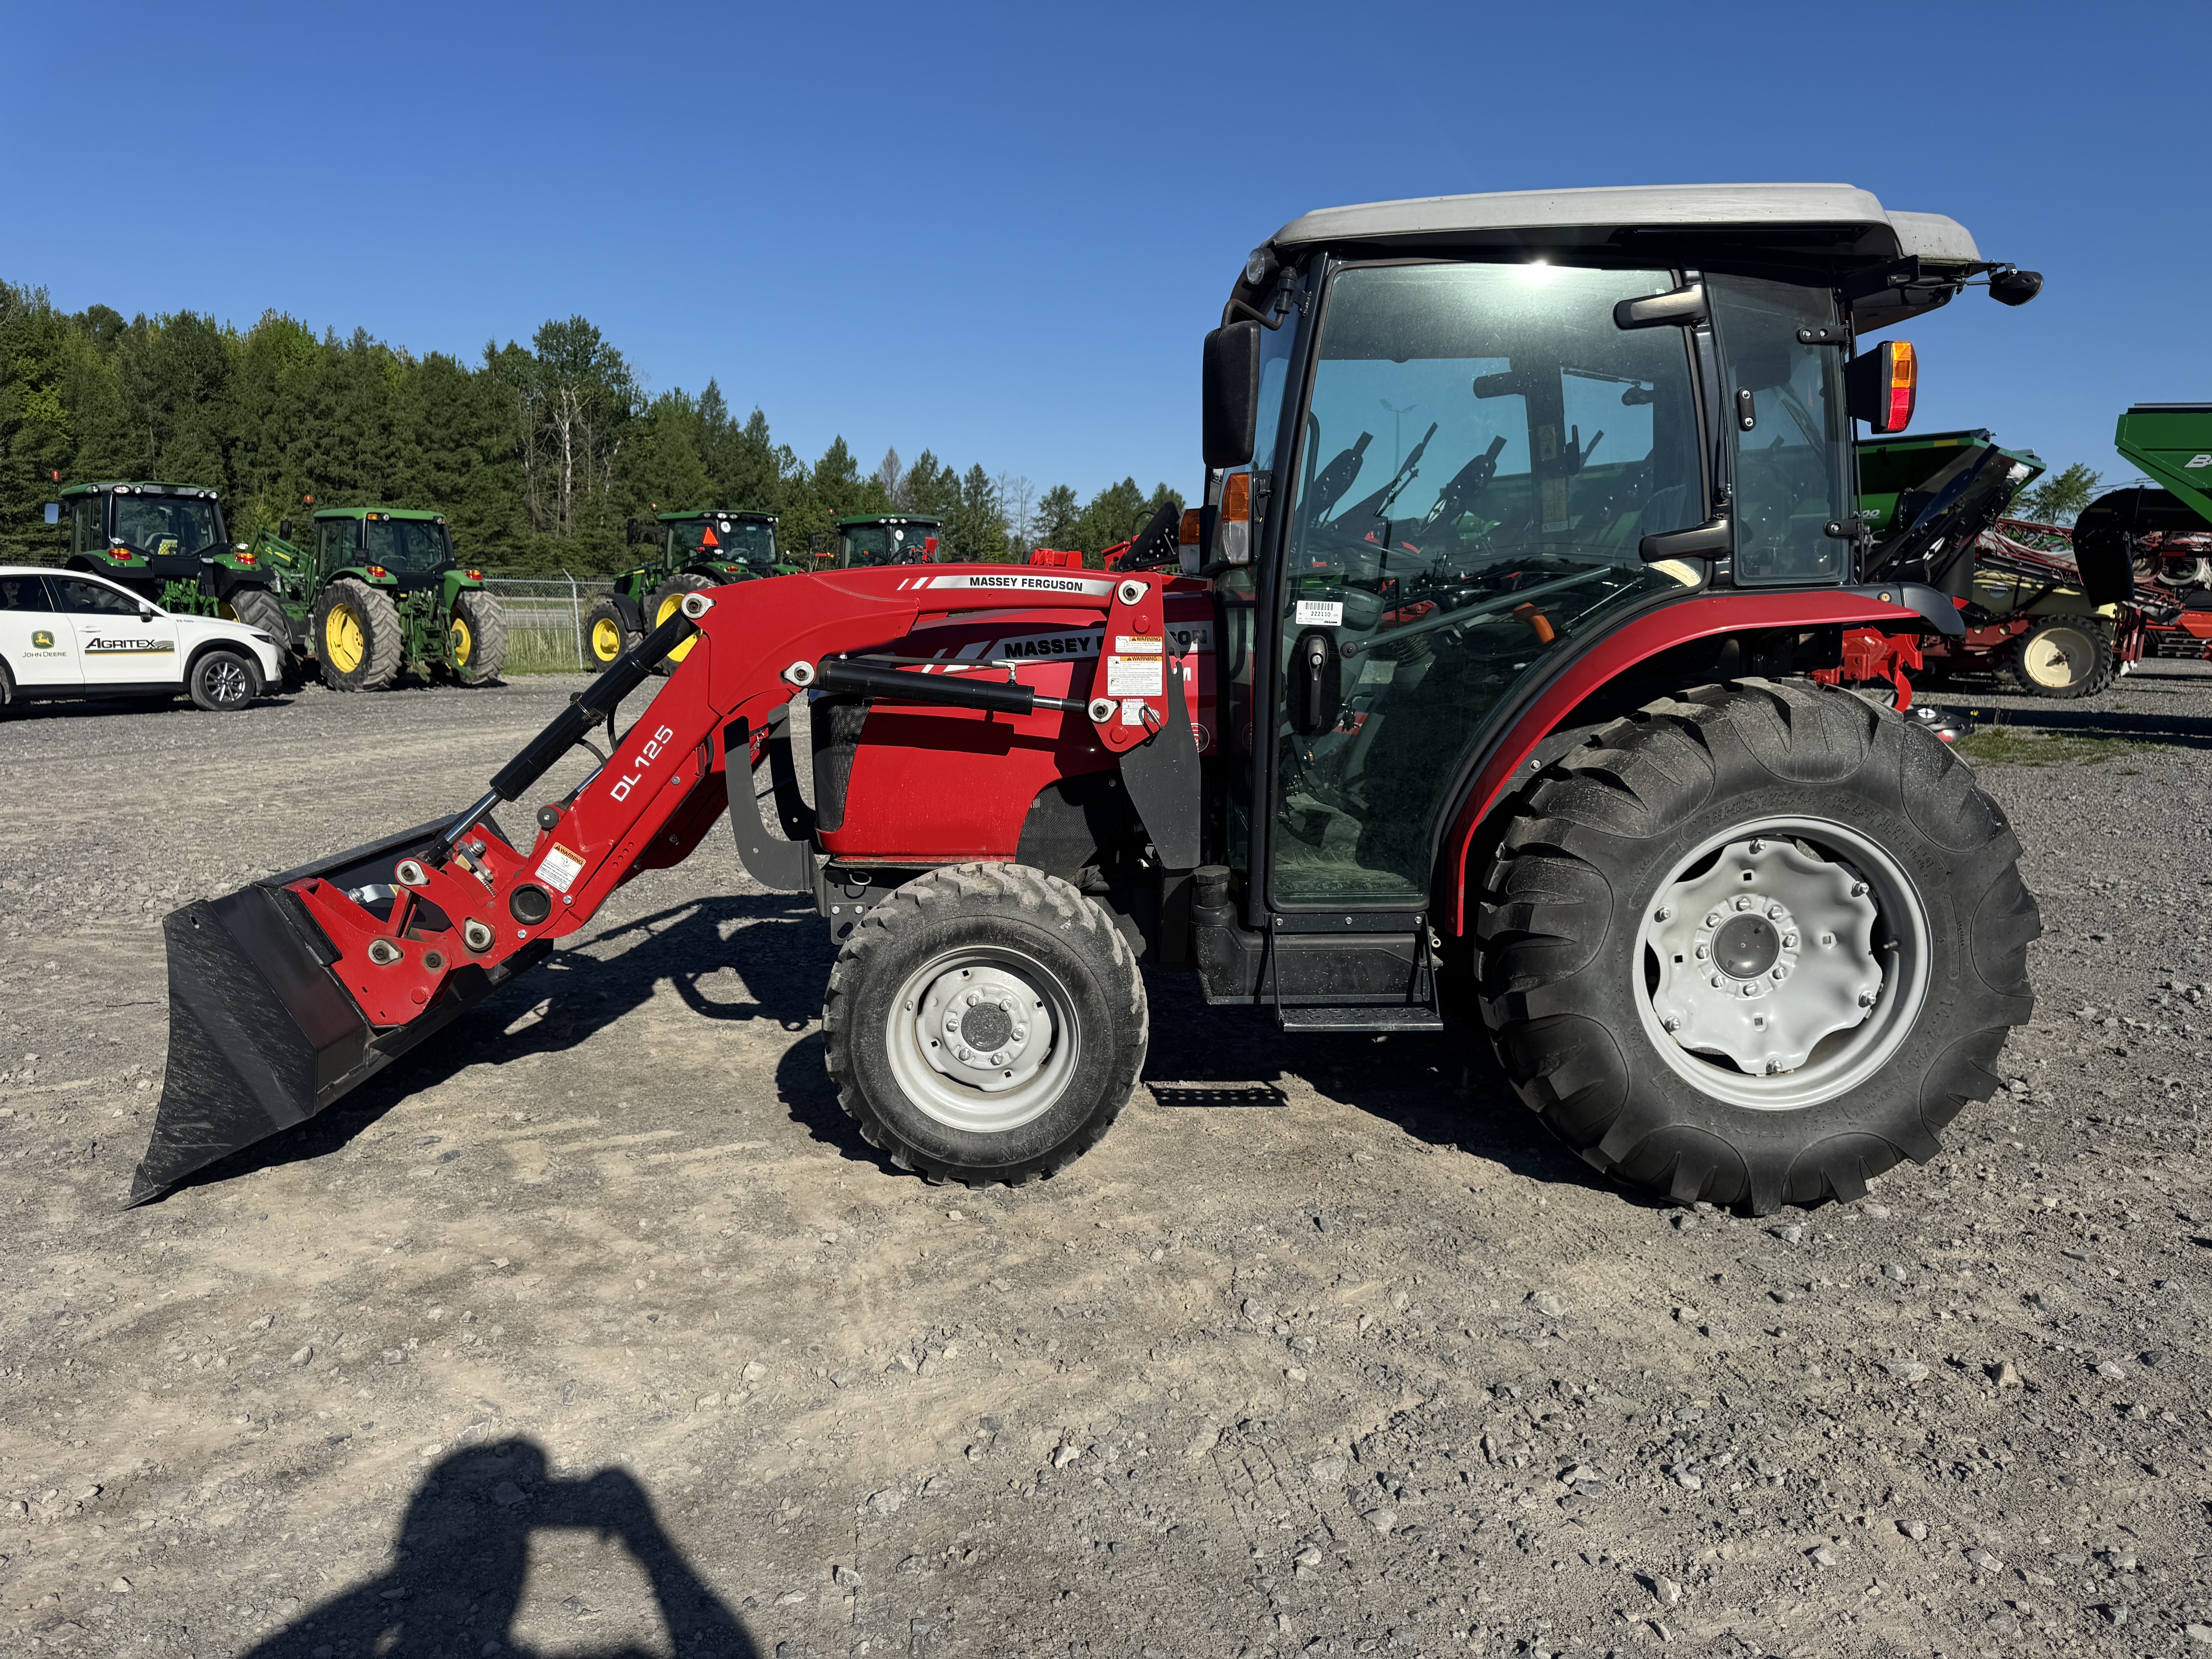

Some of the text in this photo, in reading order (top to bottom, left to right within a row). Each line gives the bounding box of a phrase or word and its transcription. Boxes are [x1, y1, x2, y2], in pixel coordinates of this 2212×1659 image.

[970, 577, 1083, 592] MASSEY FERGUSON
[85, 638, 155, 649] AGRITEX
[1004, 637, 1091, 658] MASSEY
[610, 725, 673, 802] DL 125
[560, 848, 584, 865] WARNING
[998, 1116, 1077, 1162] TITAN
